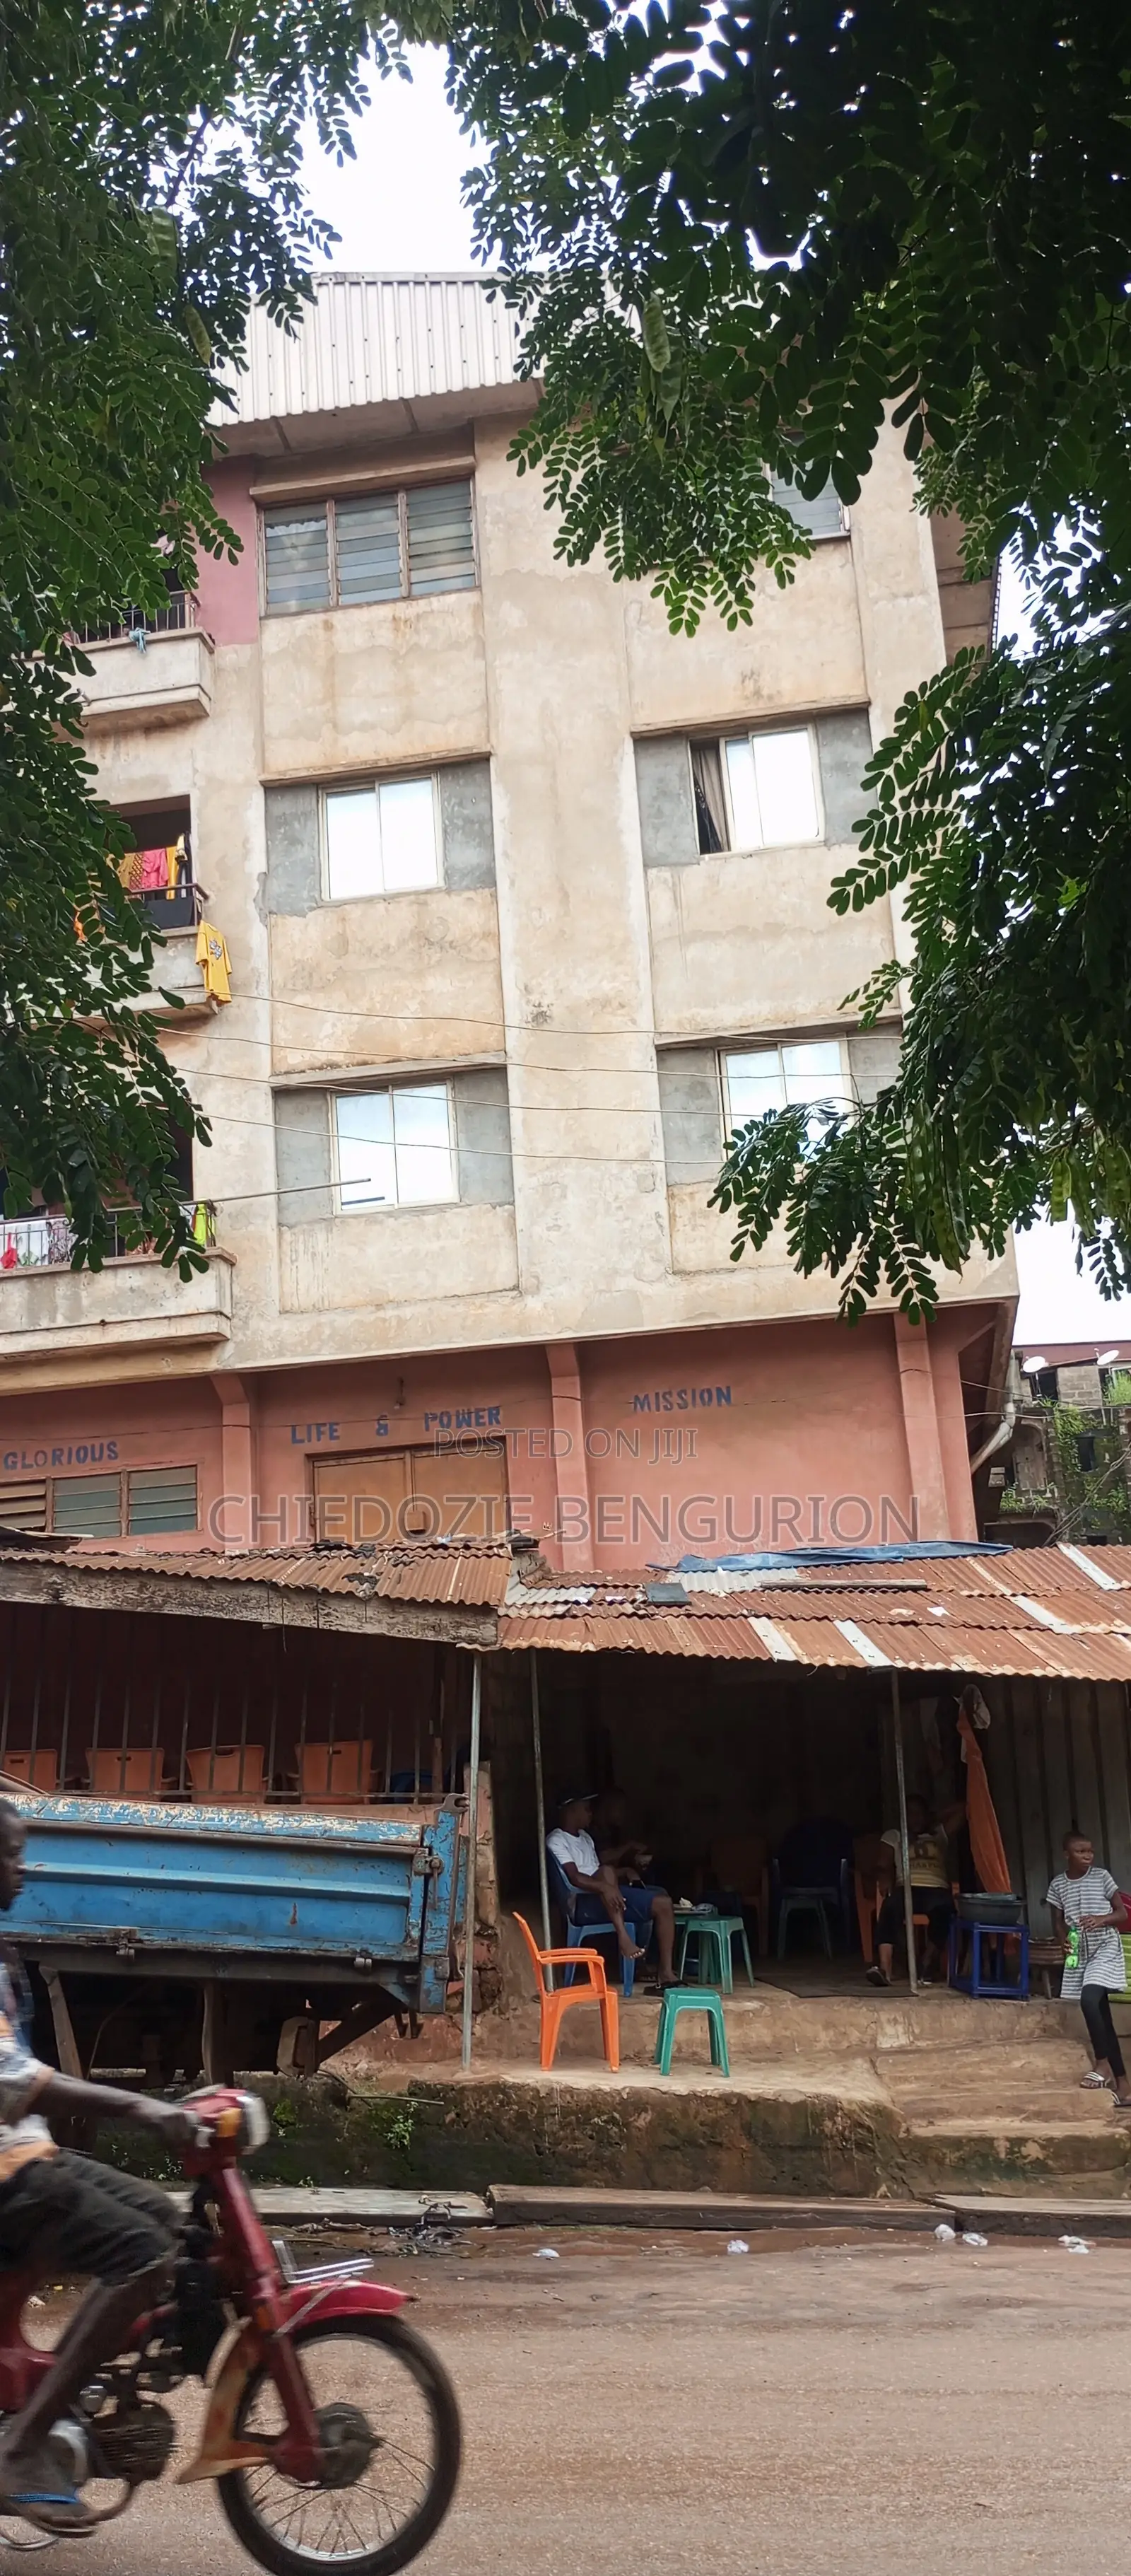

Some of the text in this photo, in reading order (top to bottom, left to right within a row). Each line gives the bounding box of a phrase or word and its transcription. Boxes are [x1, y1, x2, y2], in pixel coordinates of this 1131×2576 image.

[4, 1385, 732, 1470] GLORIOUS LIFE & POWER MISSION
